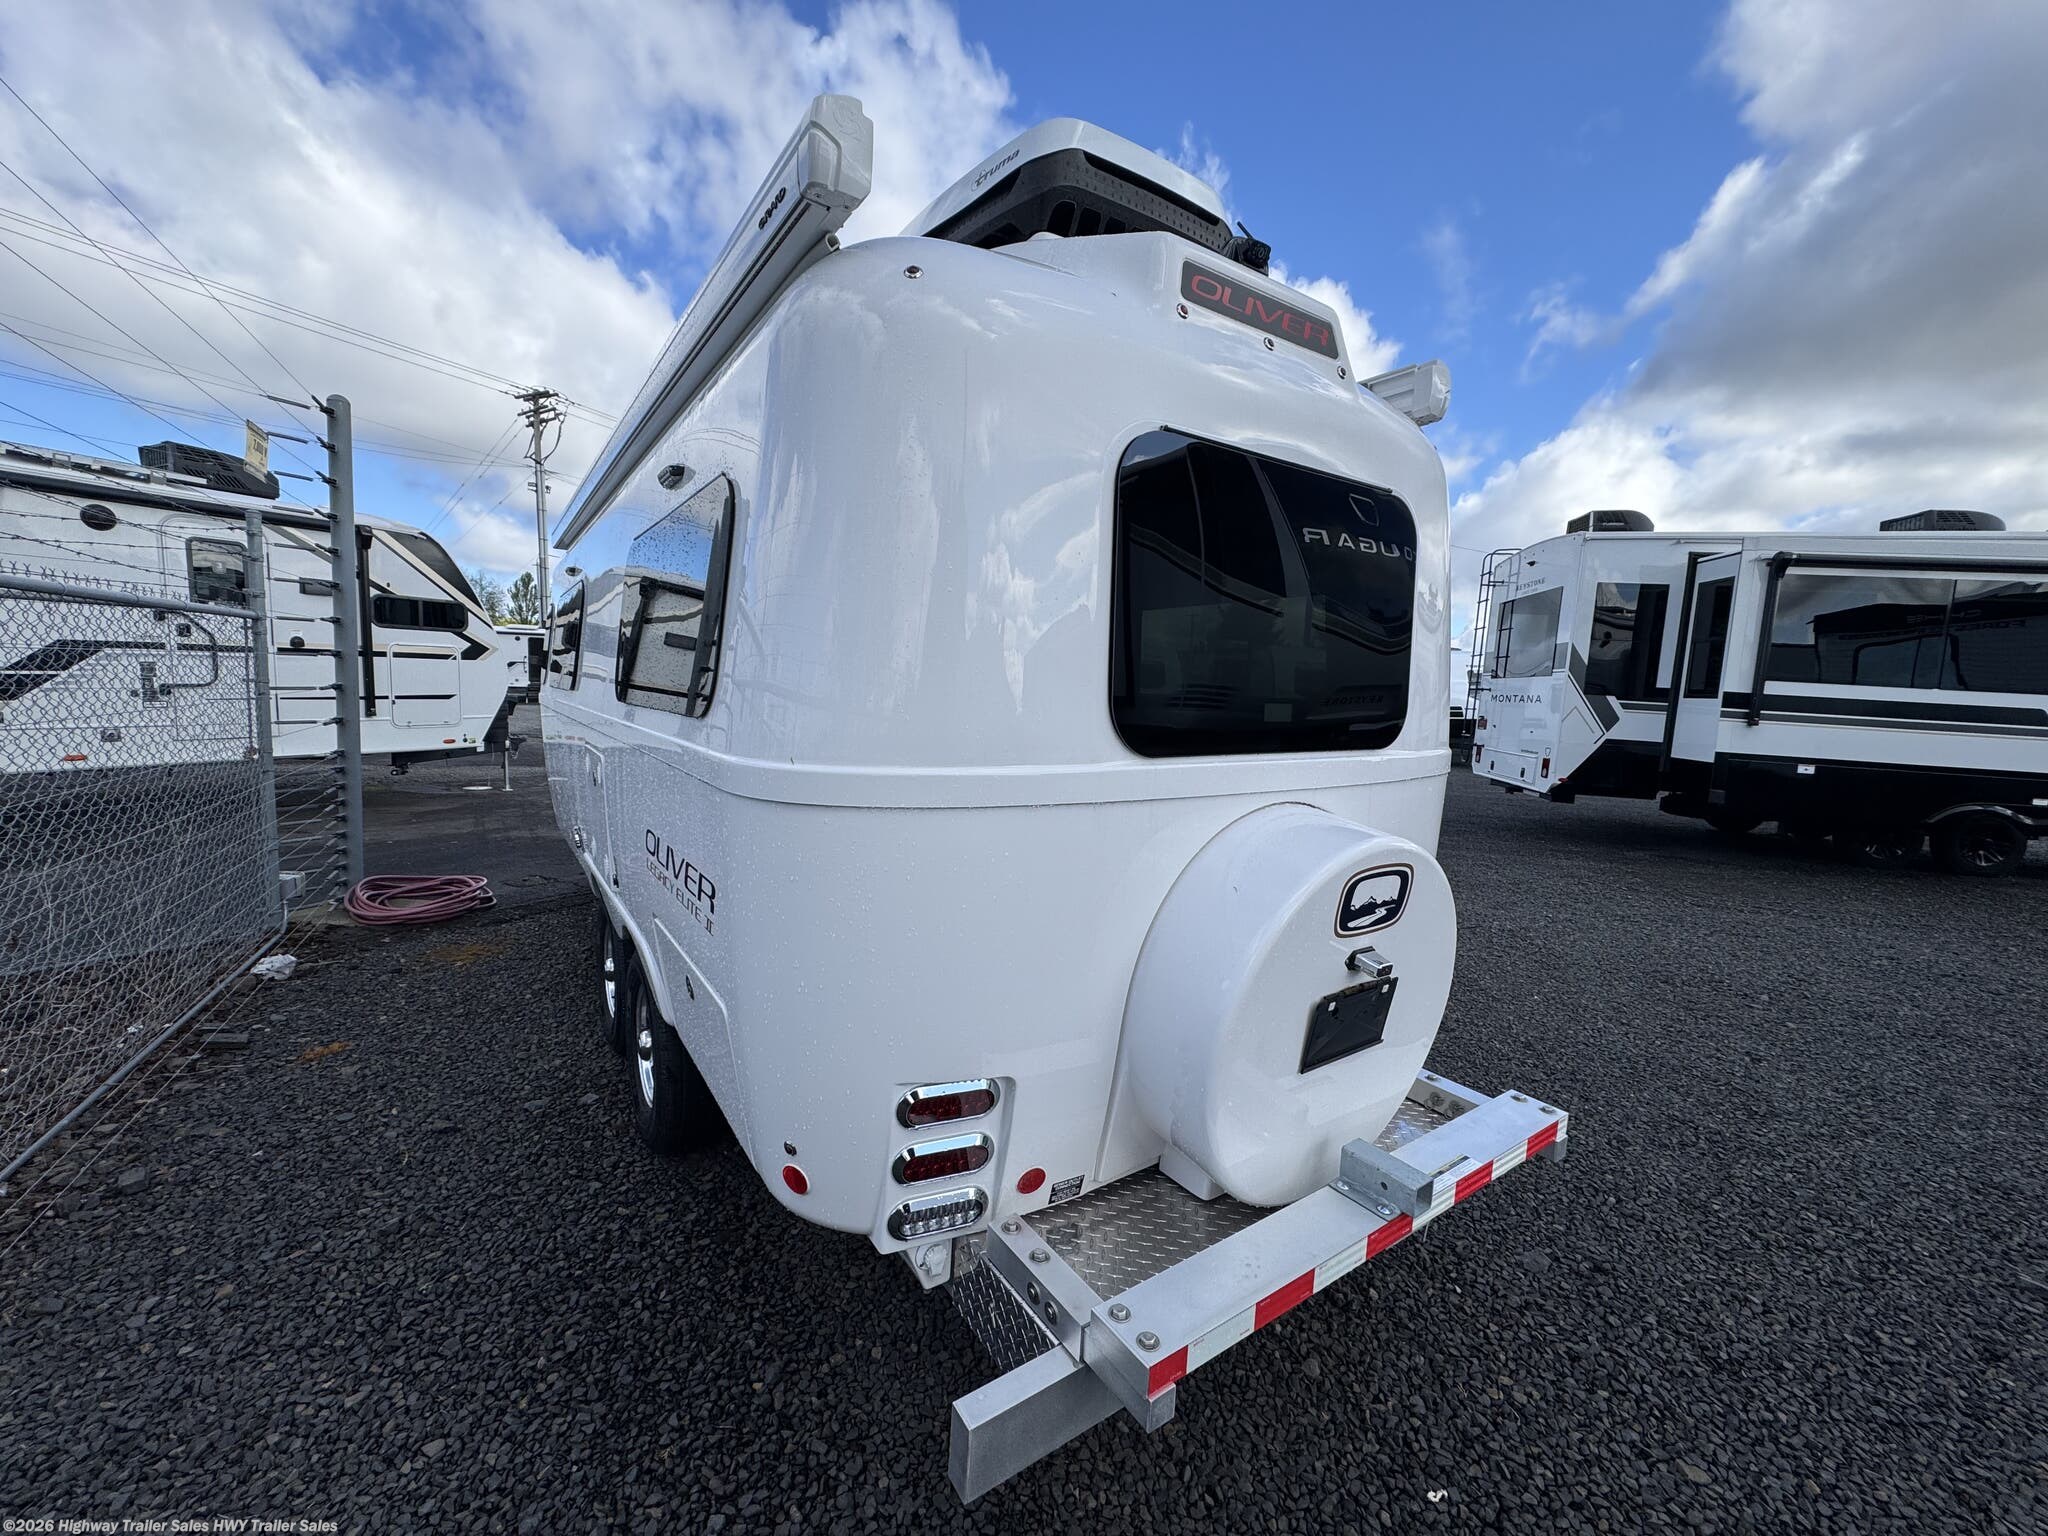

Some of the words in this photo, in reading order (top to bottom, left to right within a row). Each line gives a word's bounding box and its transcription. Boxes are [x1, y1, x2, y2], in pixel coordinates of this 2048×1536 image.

[1191, 275, 1329, 346] OLIVER
[1490, 694, 1543, 704] MONTANA
[645, 829, 716, 915] OLIVER
[676, 887, 701, 923] ELITE
